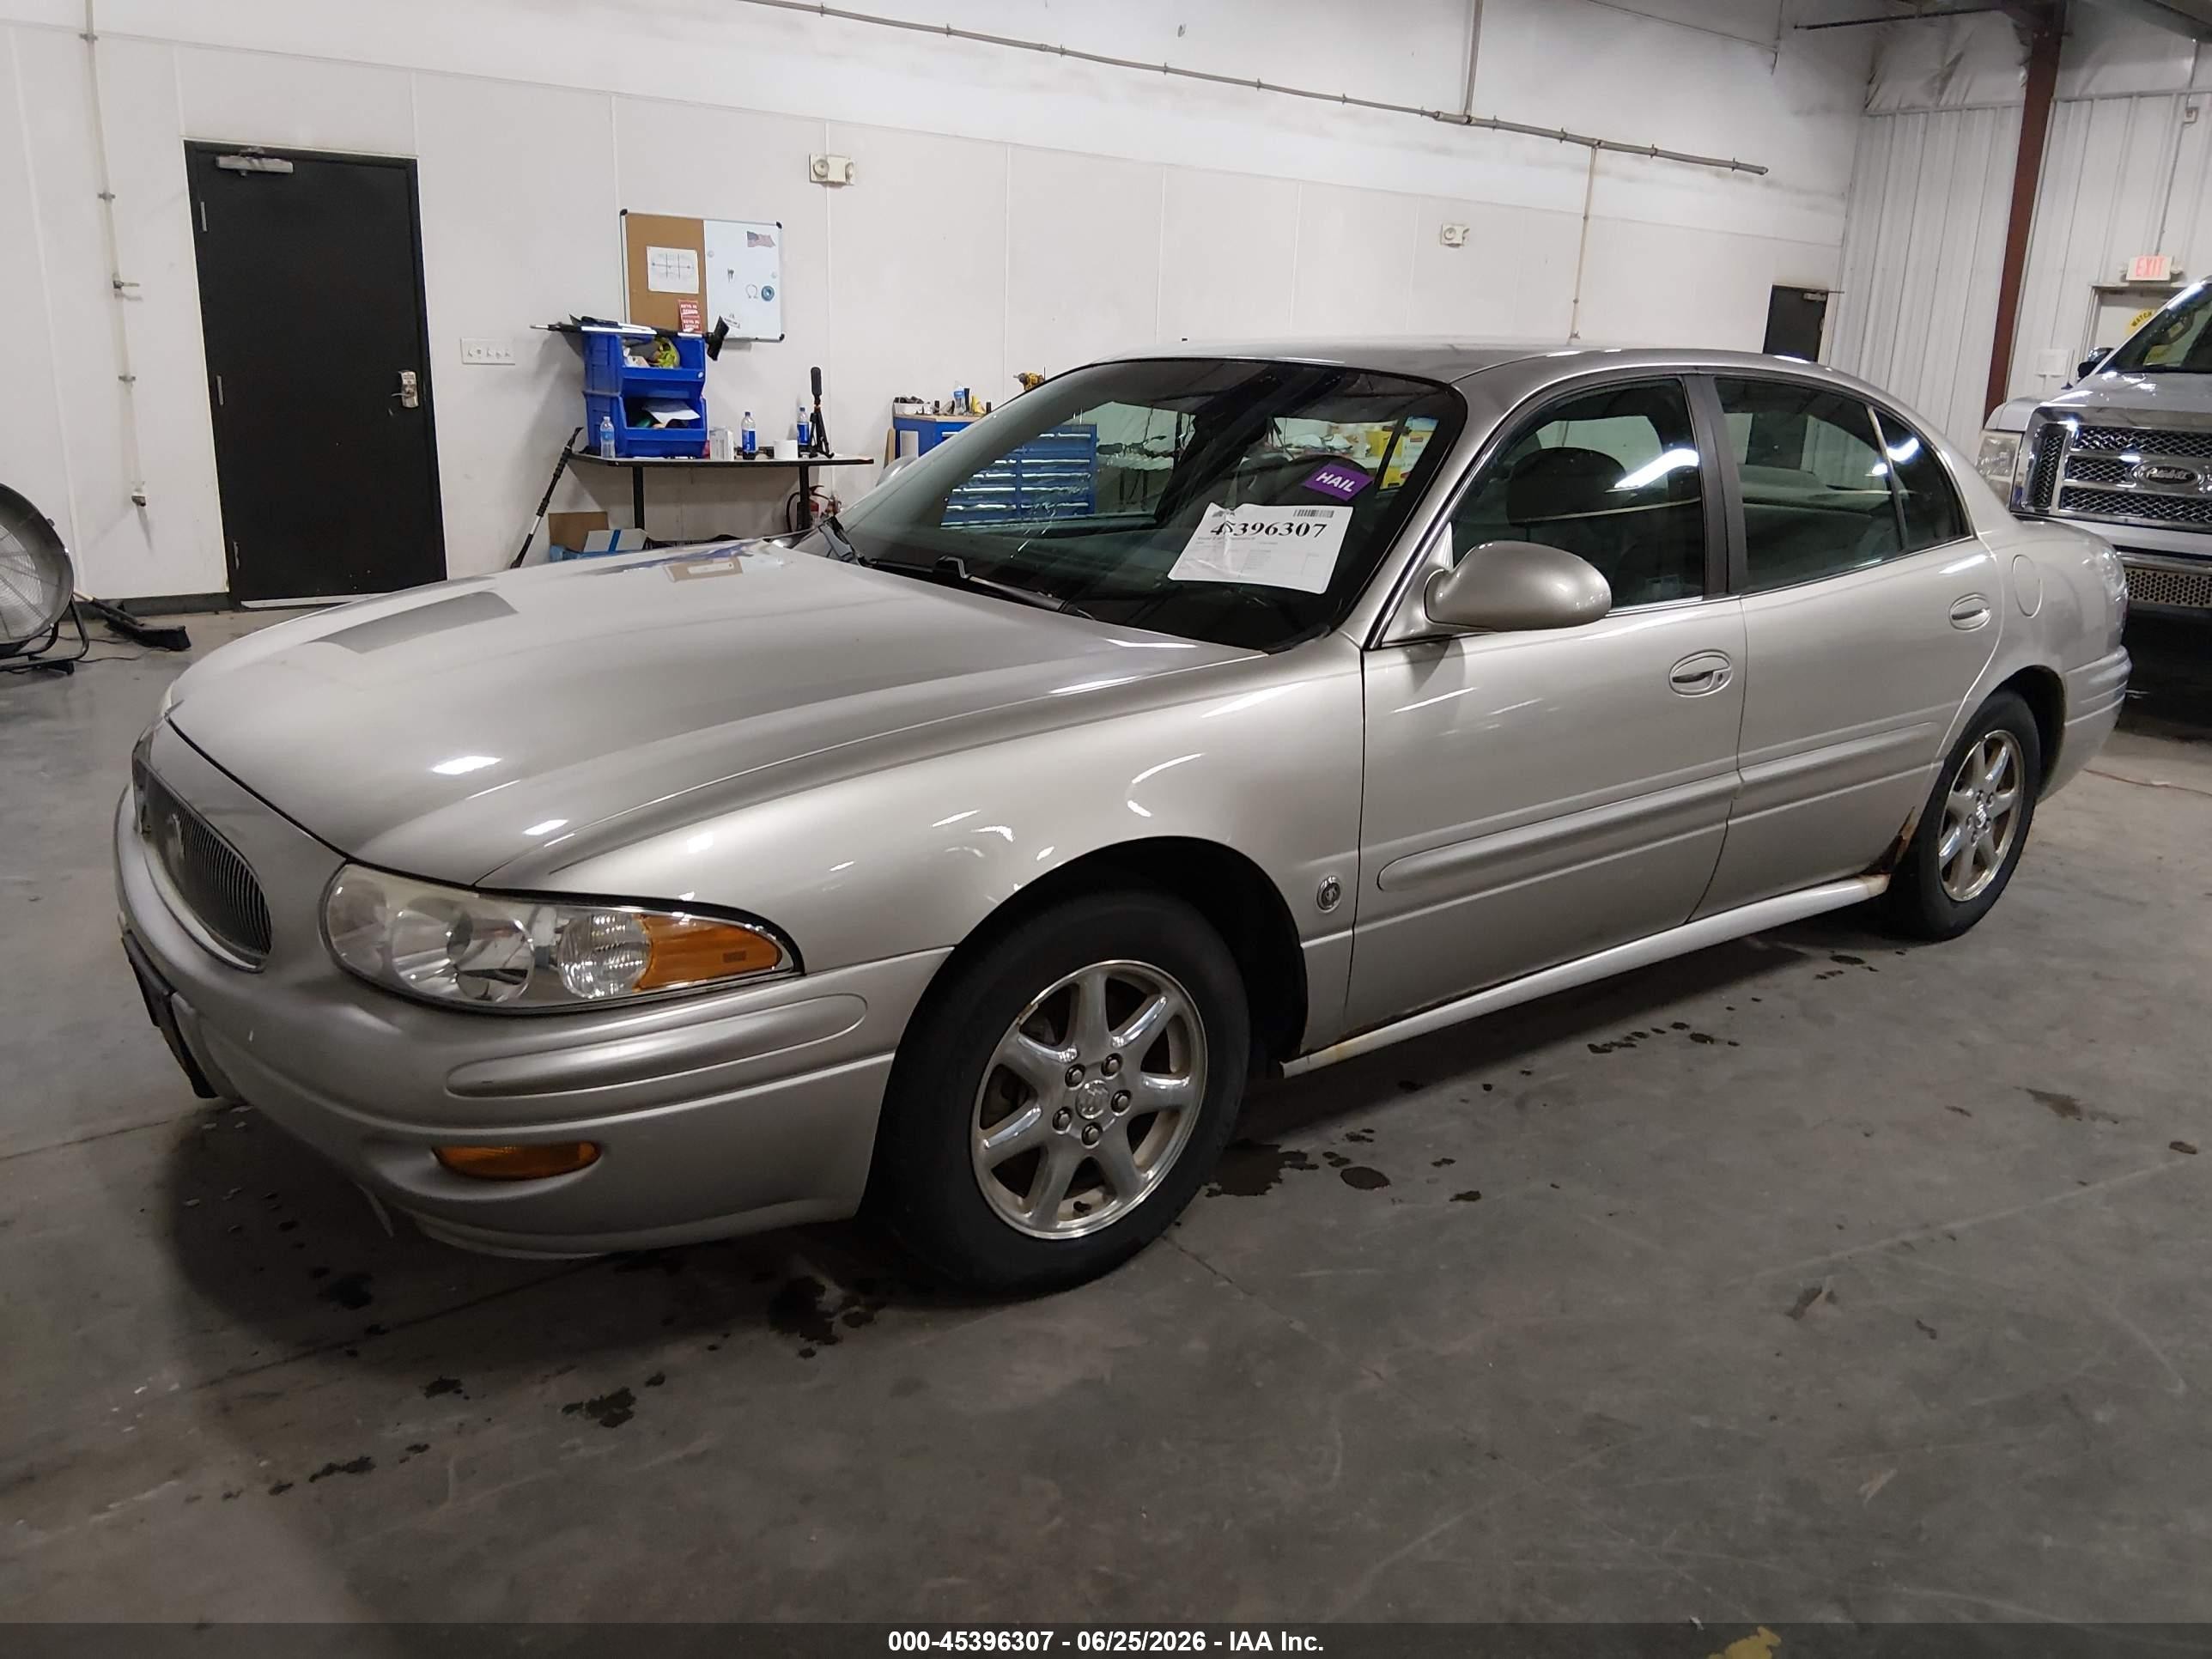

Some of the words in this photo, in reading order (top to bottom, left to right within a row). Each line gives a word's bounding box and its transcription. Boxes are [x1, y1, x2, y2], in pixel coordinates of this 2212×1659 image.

[2136, 256, 2165, 276] EXIT
[1316, 472, 1355, 492] HAIL
[1211, 521, 1327, 538] 45396307
